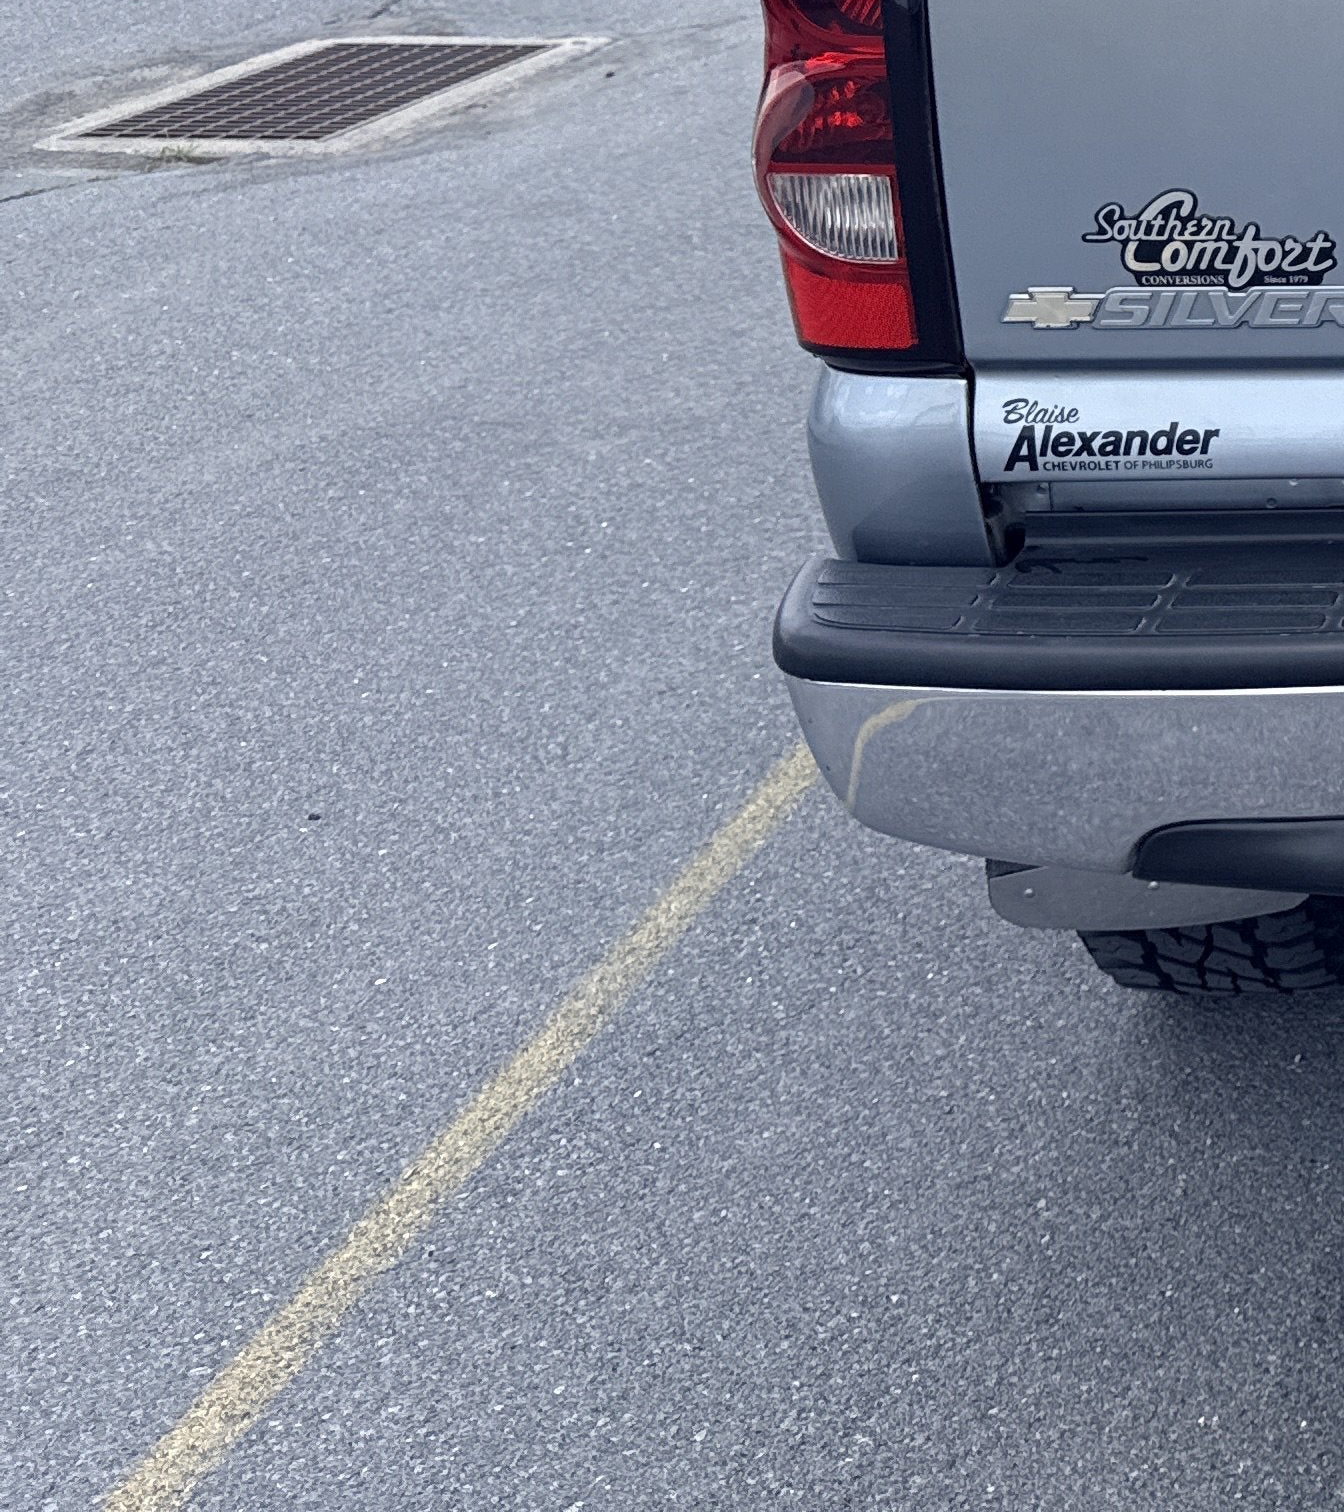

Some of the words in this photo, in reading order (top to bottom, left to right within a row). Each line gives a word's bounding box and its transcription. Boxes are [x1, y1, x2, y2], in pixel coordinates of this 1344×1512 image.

[1086, 204, 1237, 240] Southern
[1125, 191, 1333, 287] Comfort
[1142, 275, 1225, 285] CONVERSIONS
[1264, 275, 1287, 284] Since
[1002, 397, 1080, 425] Blaise
[1003, 421, 1221, 472] Alexander
[1043, 460, 1121, 472] CHEVROLET
[1124, 459, 1140, 470] OF
[1142, 459, 1214, 470] PHILIPSBURG
